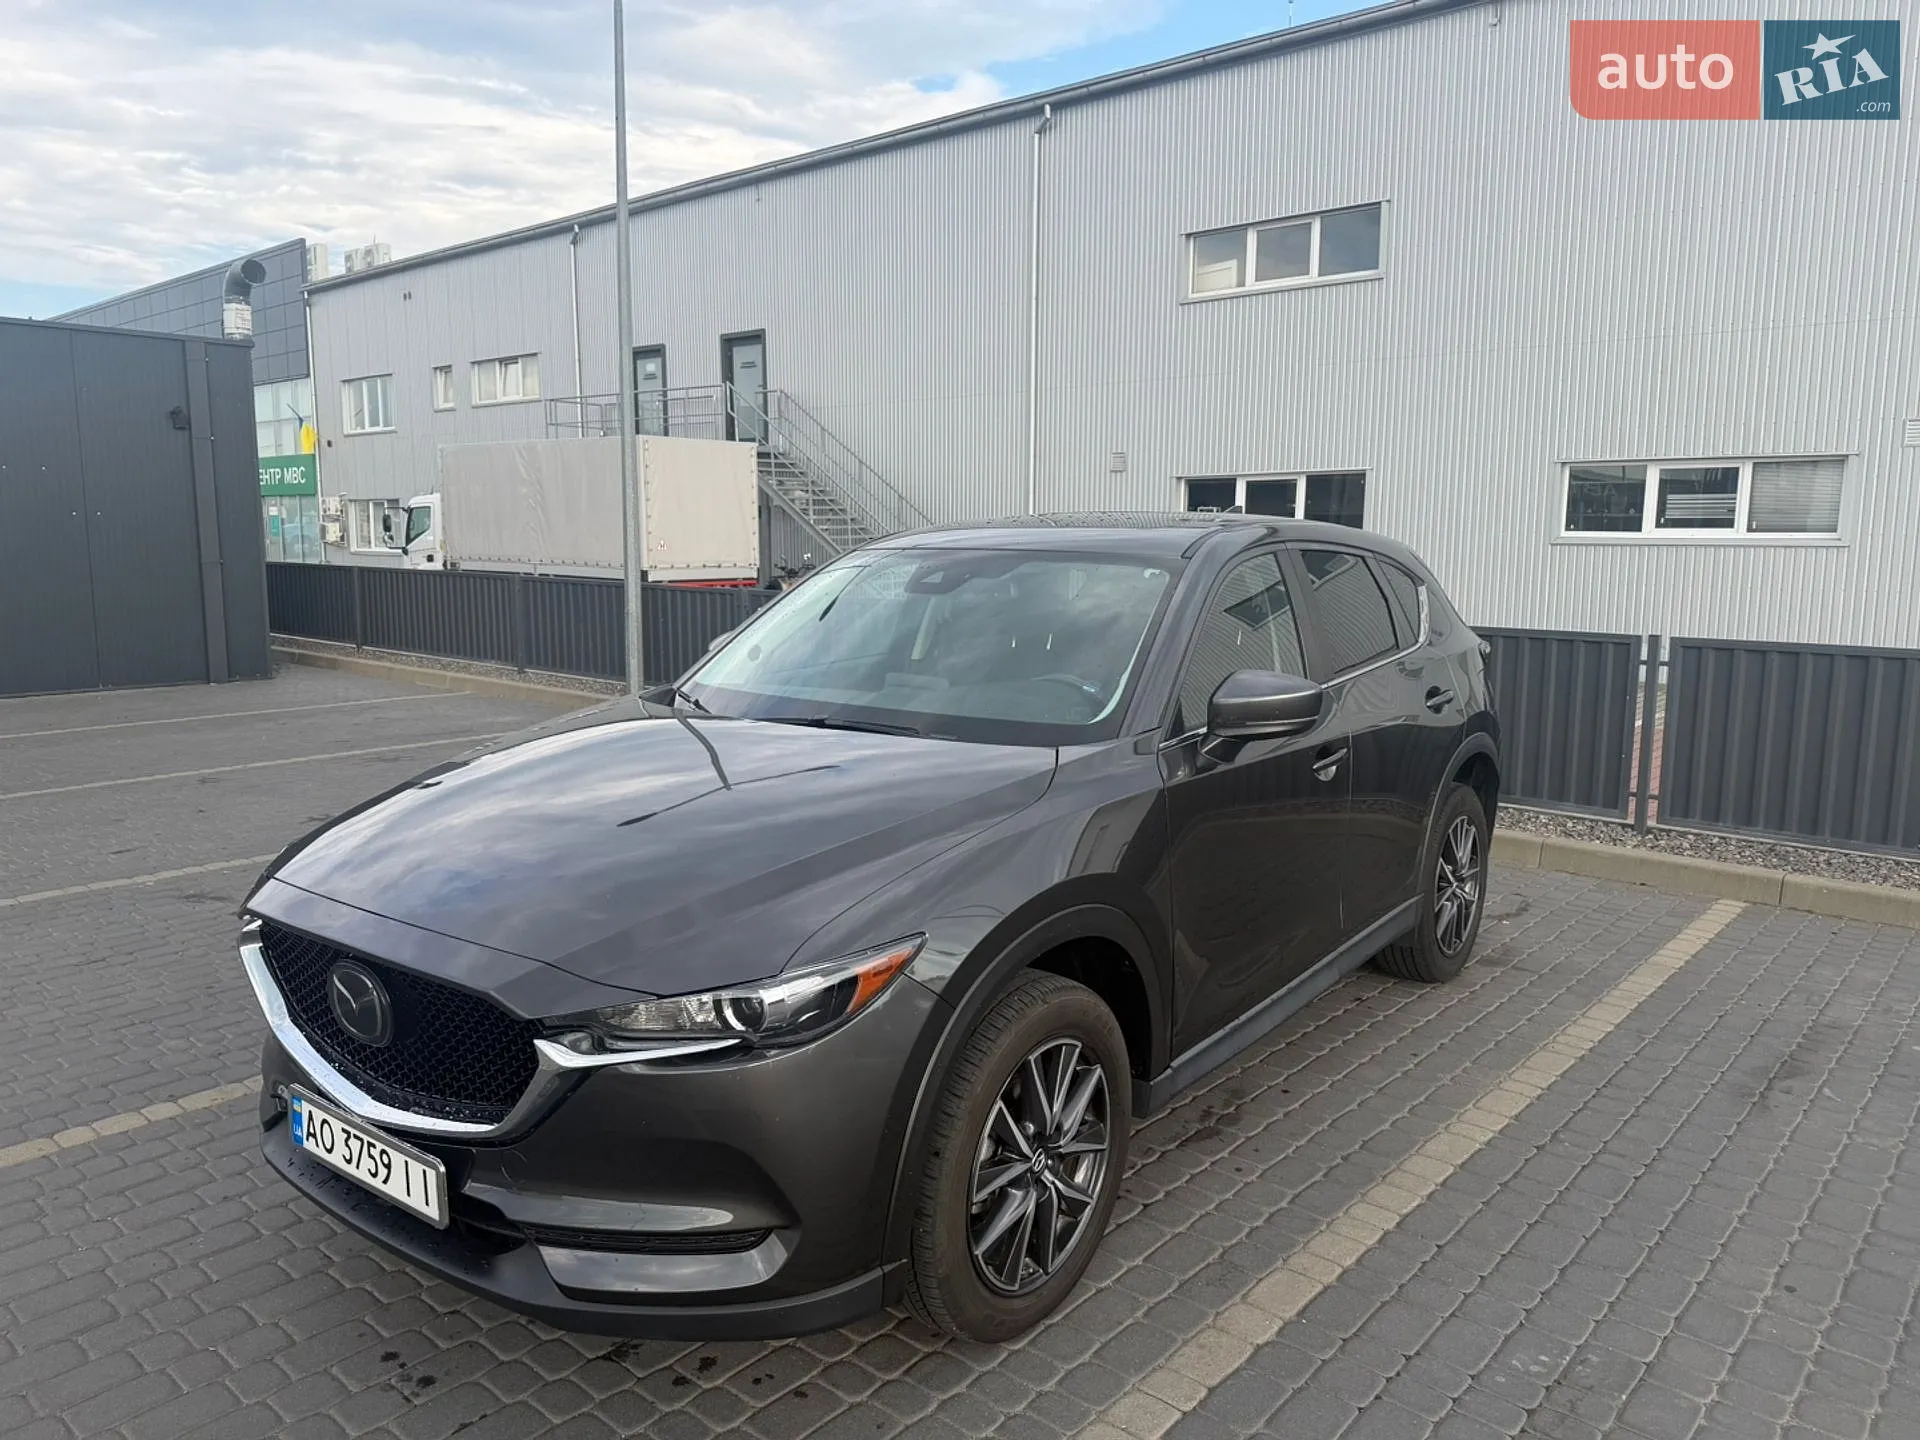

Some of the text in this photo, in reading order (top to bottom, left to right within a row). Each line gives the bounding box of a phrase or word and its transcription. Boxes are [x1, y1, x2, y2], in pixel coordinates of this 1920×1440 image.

[283, 466, 306, 484] МВС
[306, 1109, 335, 1154] AO
[341, 1127, 392, 1185] 3759
